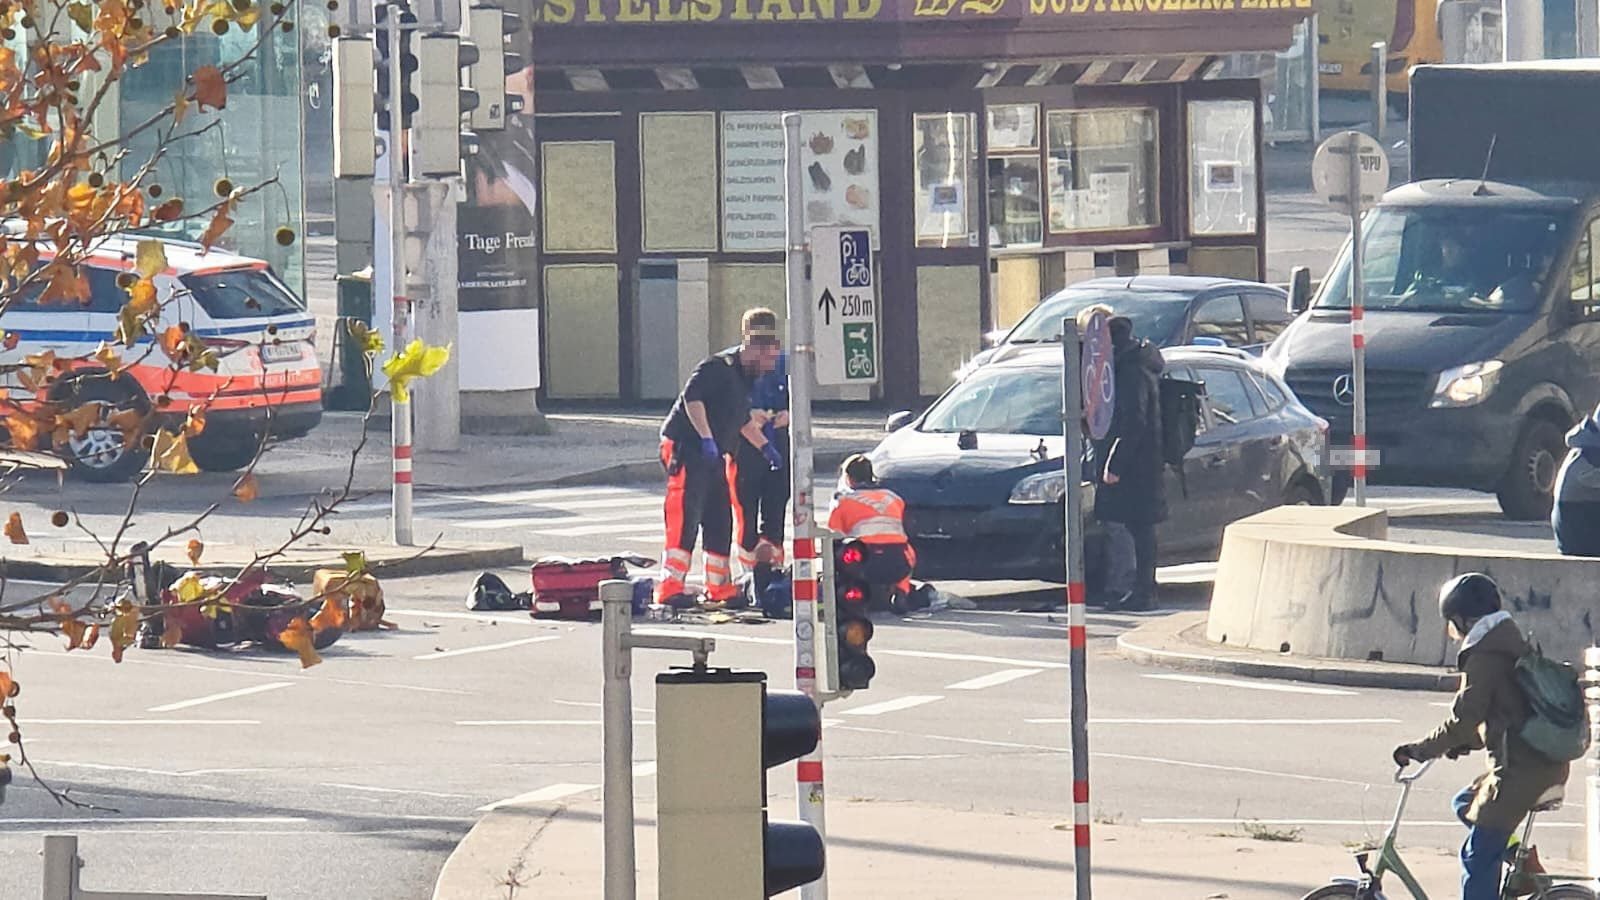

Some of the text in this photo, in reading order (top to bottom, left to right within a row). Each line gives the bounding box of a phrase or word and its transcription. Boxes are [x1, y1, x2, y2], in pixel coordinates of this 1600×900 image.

[532, 0, 882, 24] STELSTAND
[464, 233, 501, 254] Tage
[841, 295, 873, 317] 250 m
